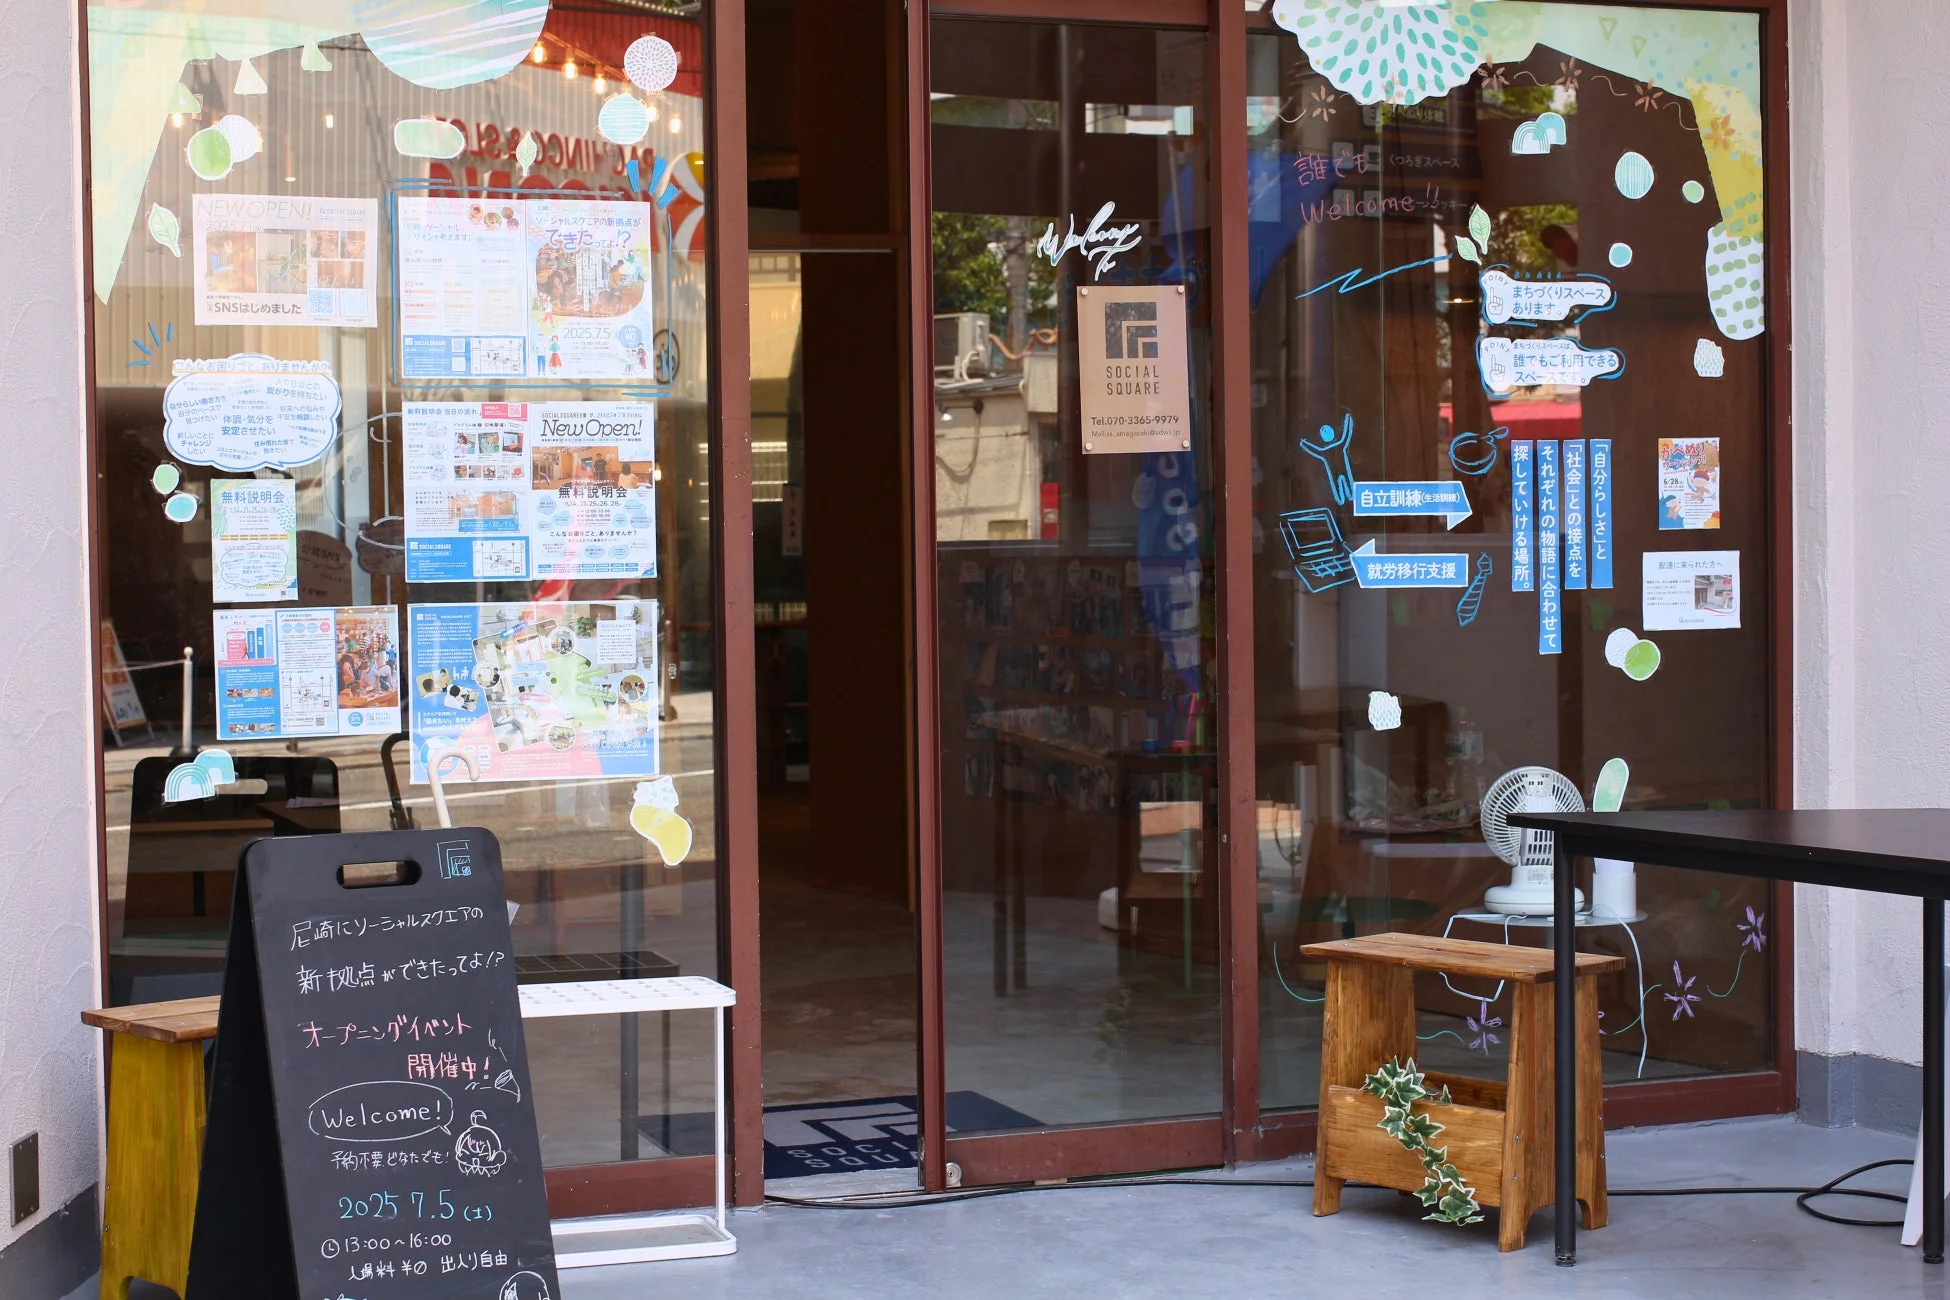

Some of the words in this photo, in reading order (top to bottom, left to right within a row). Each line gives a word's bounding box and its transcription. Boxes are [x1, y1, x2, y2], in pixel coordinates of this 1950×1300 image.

[1293, 149, 1371, 186] 誰でも
[1389, 154, 1461, 169] くつろぎスペース
[197, 199, 246, 218] NEW
[247, 201, 312, 221] OPEN!
[1483, 274, 1509, 288] POINT
[1512, 286, 1606, 301] まちづくりスペース
[213, 302, 302, 314] SNSはじめました
[1512, 301, 1562, 316] あります。
[563, 327, 612, 341] 2025.7.5
[1484, 343, 1511, 353] POINT
[1513, 342, 1574, 351] まちづくりスペースは、
[1513, 354, 1617, 368] 誰でもご利用できる
[1106, 365, 1159, 379] SOCIAL
[1515, 370, 1587, 384] スペースです。
[1106, 382, 1160, 396] SQUARE
[178, 404, 222, 418] 自分のペースで
[222, 414, 274, 425] 体調・気分を
[1091, 415, 1179, 427] Tel.070-3365-9979
[220, 426, 277, 437] 安定させたい
[540, 419, 584, 437] New
[585, 418, 642, 438] Open!
[181, 439, 212, 448] チャレンジ
[186, 448, 206, 456] したい
[221, 490, 285, 504] 無料説明会
[558, 486, 628, 499] 無料説明会
[1360, 489, 1461, 508] 自立訓練(生活訓練)
[1592, 444, 1609, 561] 「自分らしさ」と
[1513, 444, 1530, 589] 探していける場所。
[1566, 444, 1583, 578] 「社会」との接点を
[1540, 445, 1558, 648] それぞれの物語に合わせて
[1367, 562, 1457, 580] 就労移行支援
[1658, 561, 1724, 570] 配達に来られた方へ
[290, 906, 485, 952] 尼崎にソーシャルスクエアの
[295, 950, 506, 995] 新拠点ができたってよ!?
[301, 1011, 473, 1049] オープニングイベント
[407, 1050, 490, 1084] 開催中!
[321, 1099, 441, 1129] Welcome!
[338, 1190, 400, 1220] 2025
[410, 1188, 455, 1220] 7.5
[463, 1205, 493, 1222] (土)
[347, 1260, 396, 1281] 入場料
[440, 1249, 508, 1275] 出入り自由
